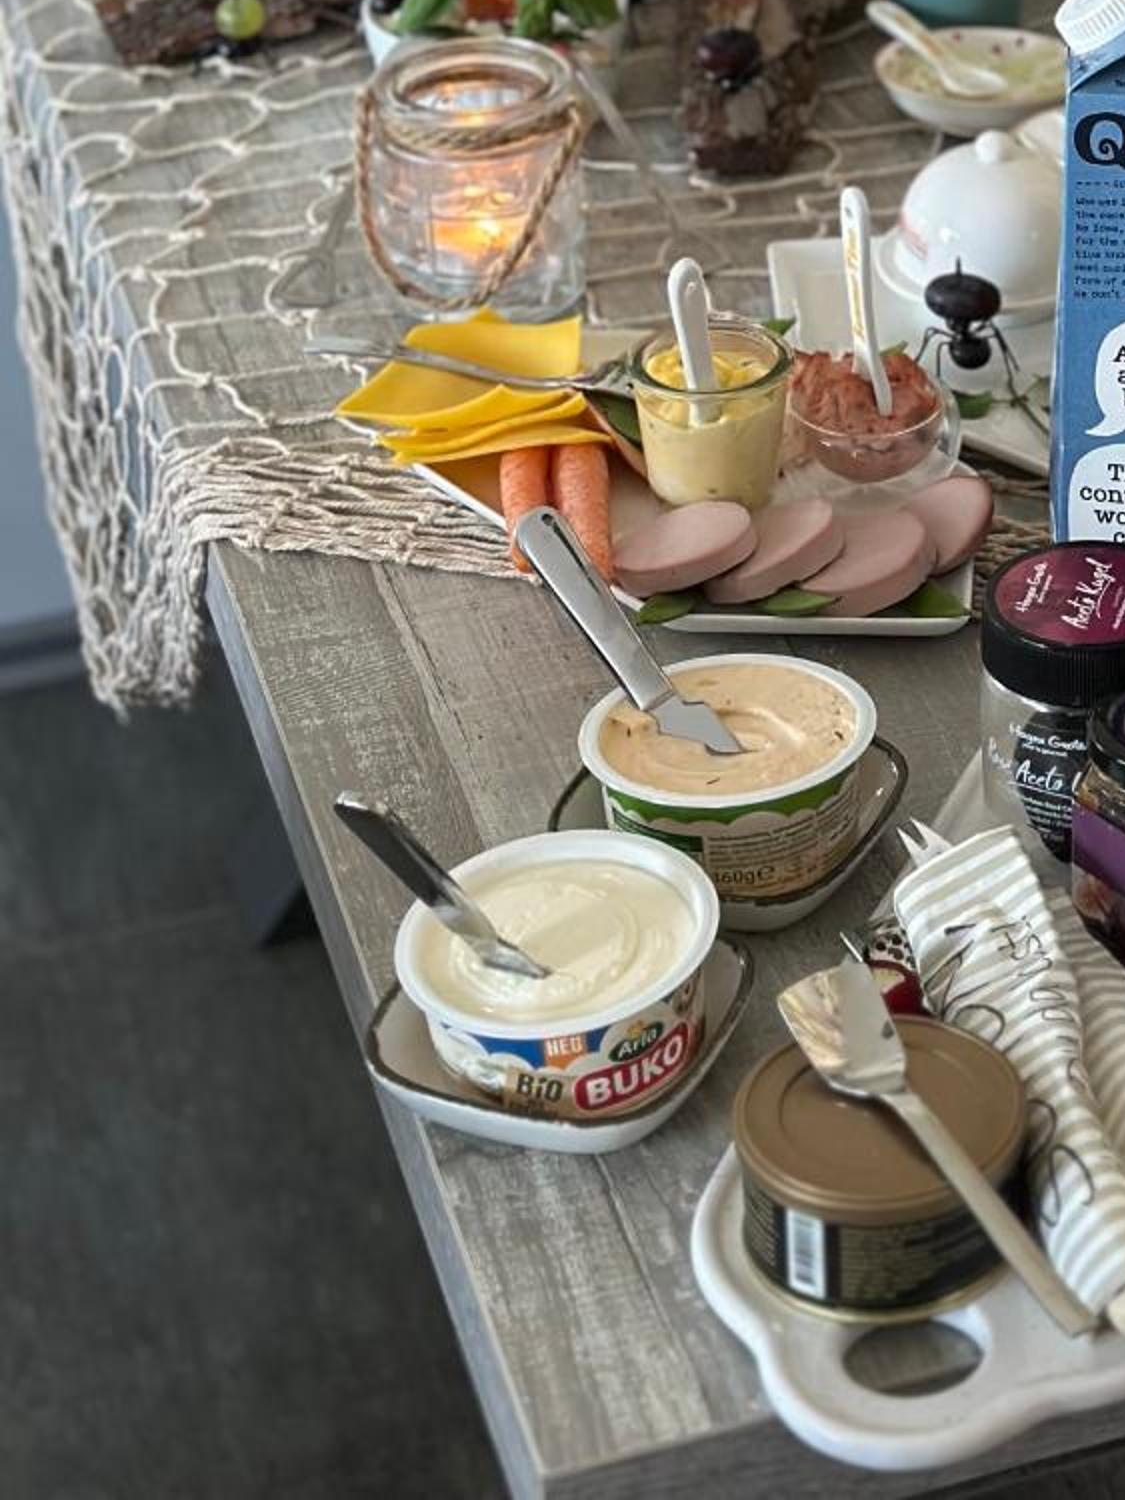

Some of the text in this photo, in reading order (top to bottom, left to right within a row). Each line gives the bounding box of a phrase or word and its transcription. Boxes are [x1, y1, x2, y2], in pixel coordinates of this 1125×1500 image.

[1015, 759, 1064, 791] Aceto
[617, 1028, 659, 1060] Arla
[584, 1033, 685, 1107] BUKO
